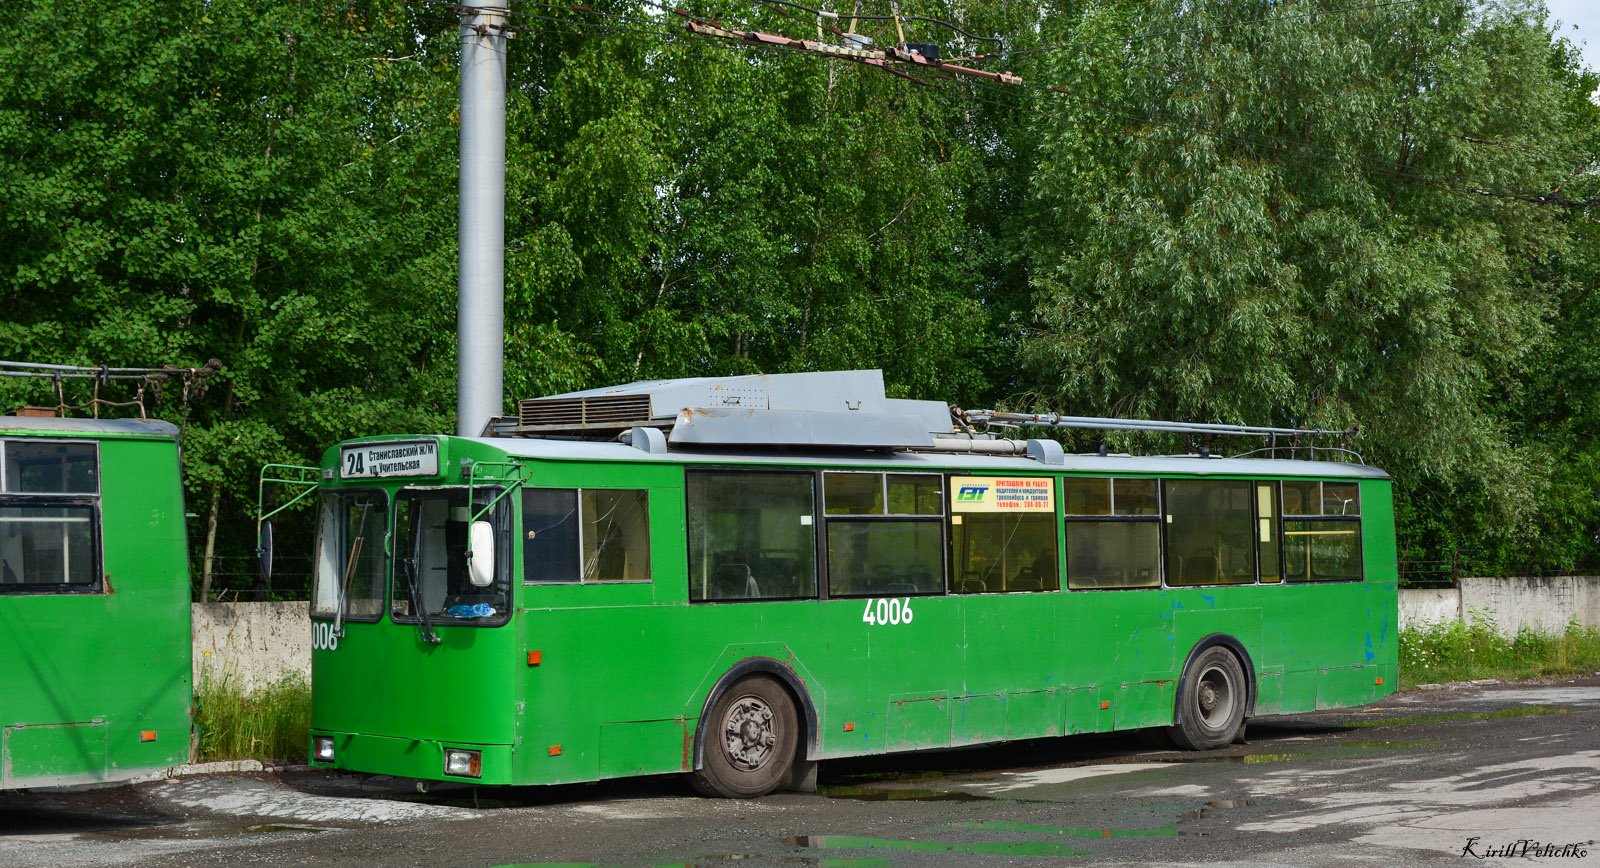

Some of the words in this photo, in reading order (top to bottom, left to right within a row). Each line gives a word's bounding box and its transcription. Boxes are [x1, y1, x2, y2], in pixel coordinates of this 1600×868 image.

[368, 445, 418, 461] Станиславский
[419, 443, 434, 456] ж/м
[347, 452, 365, 475] 24
[369, 465, 378, 475] ул
[379, 460, 420, 473] Учительская
[863, 597, 913, 626] 4006
